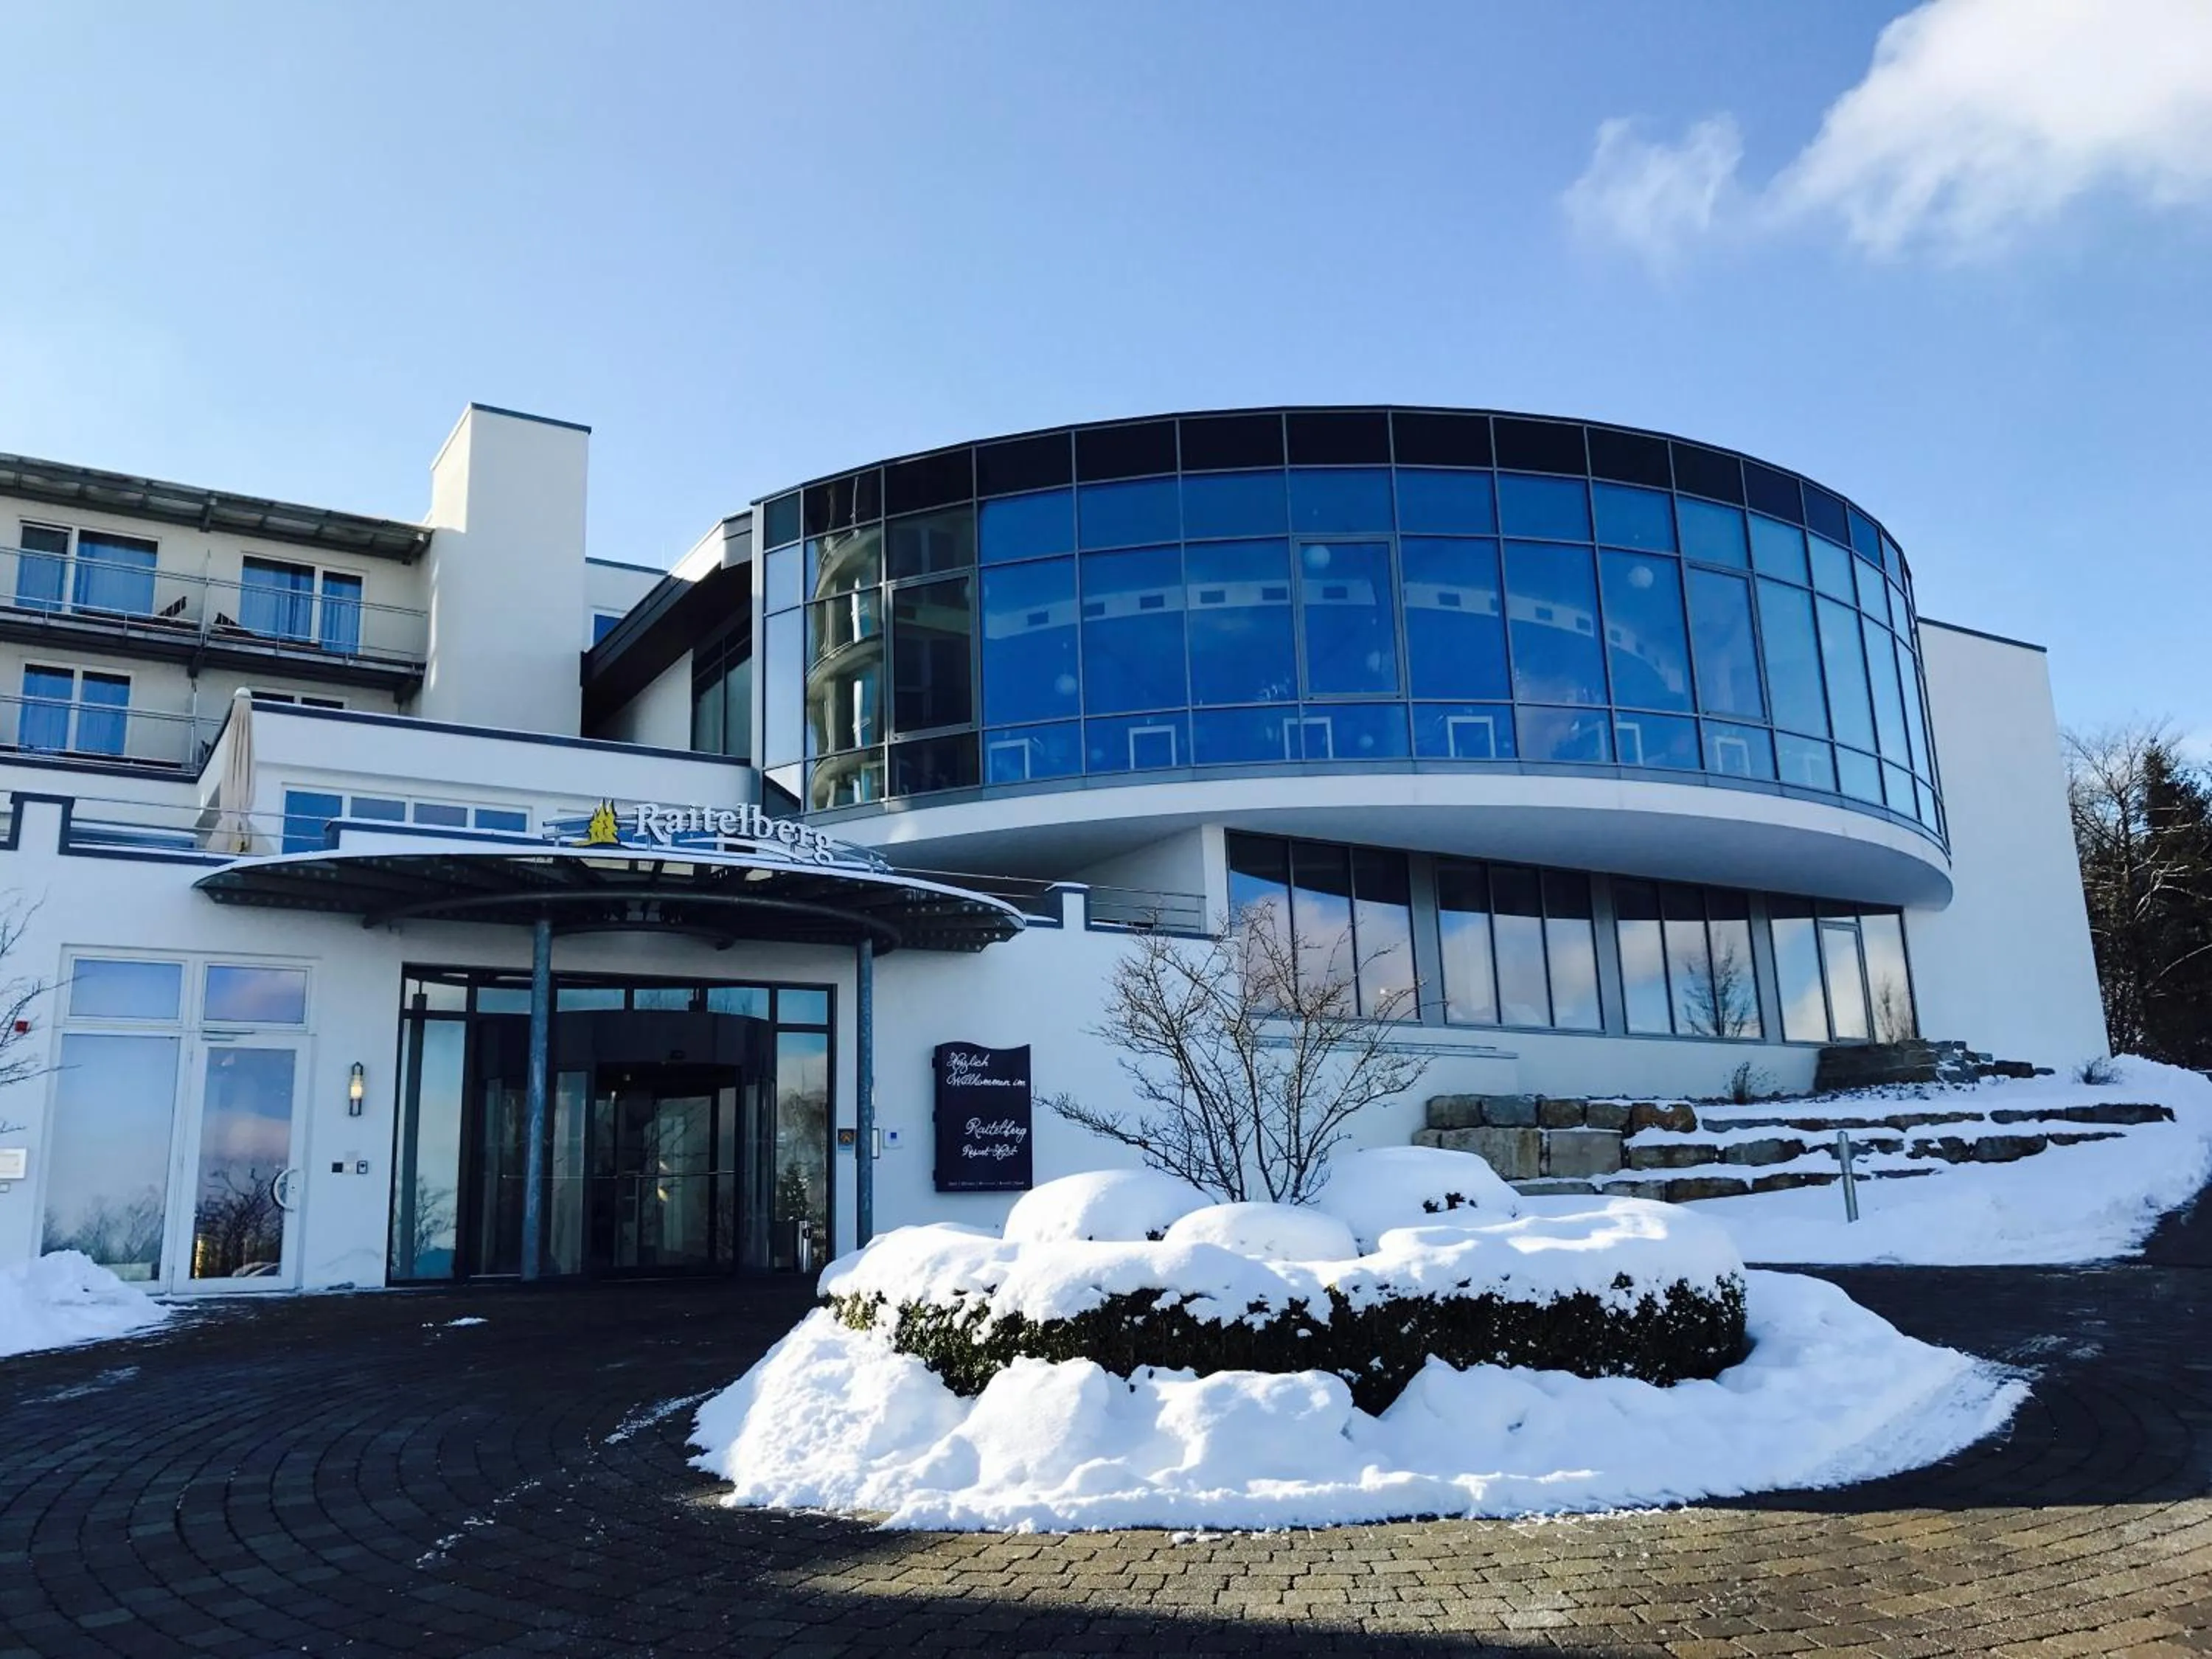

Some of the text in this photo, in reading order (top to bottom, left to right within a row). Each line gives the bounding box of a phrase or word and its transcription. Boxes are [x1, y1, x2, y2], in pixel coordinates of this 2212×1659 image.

[634, 803, 835, 866] Raitelberg
[946, 1074, 1011, 1086] Willkommen
[964, 1118, 1027, 1144] Raitelberg
